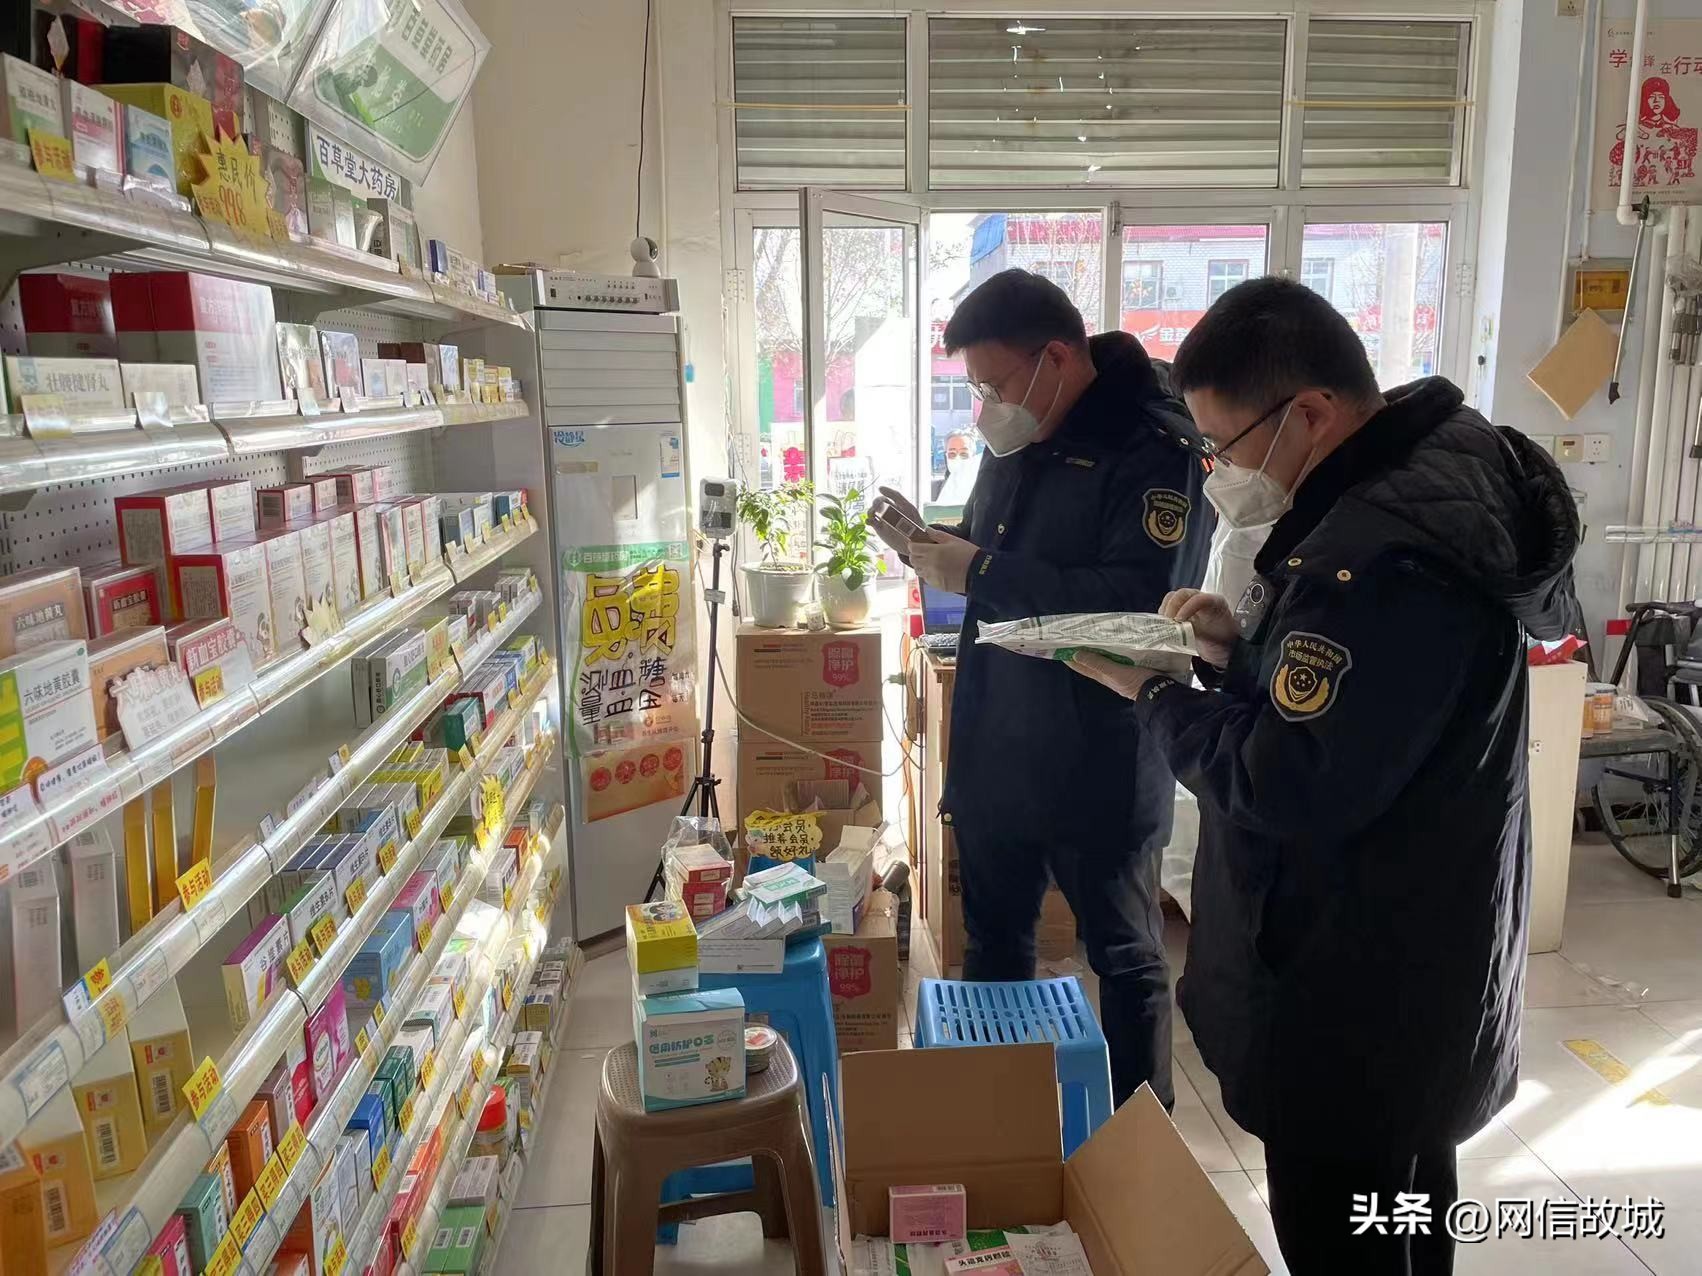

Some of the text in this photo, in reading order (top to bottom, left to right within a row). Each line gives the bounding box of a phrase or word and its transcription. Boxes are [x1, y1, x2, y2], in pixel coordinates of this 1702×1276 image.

[1610, 48, 1702, 75] 学锋在行
[317, 136, 399, 200] 百草堂大药房
[46, 371, 110, 393] 壮腰健肾丸
[15, 604, 64, 632] 六味地黄丸
[583, 564, 681, 666] 免费
[186, 628, 237, 671] 新血宝胶囊
[1287, 640, 1342, 664] 中华人民共和国
[1288, 650, 1334, 670] 市场监管执法
[23, 669, 81, 706] 六味地黄胶囊
[581, 657, 667, 696] 测血糖
[579, 689, 662, 725] 量血压
[763, 833, 808, 845] 推荐会员
